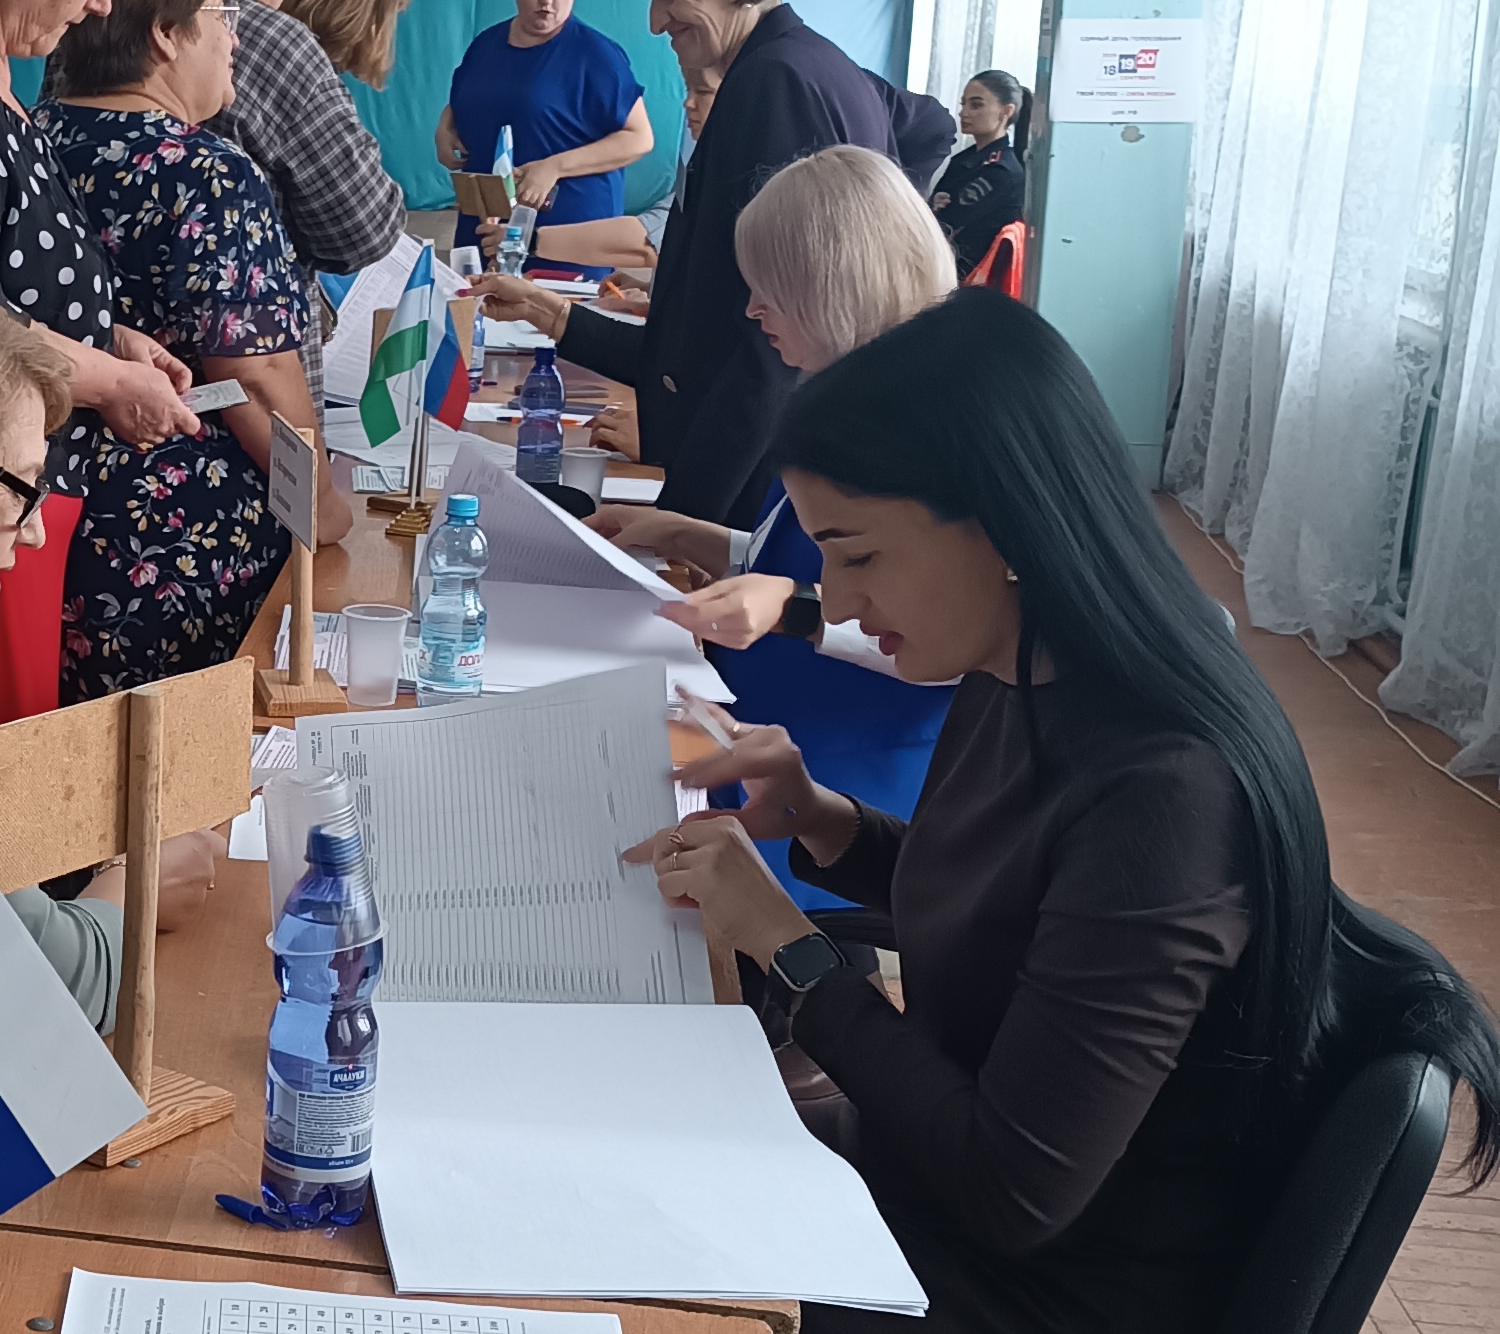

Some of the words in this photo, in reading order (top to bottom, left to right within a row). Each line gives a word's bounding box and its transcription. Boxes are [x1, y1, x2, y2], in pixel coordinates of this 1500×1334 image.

[1120, 58, 1135, 70] 19
[1137, 53, 1155, 65] 20
[1103, 65, 1117, 76] 18
[333, 1070, 365, 1083] АЧАЛУКИ
